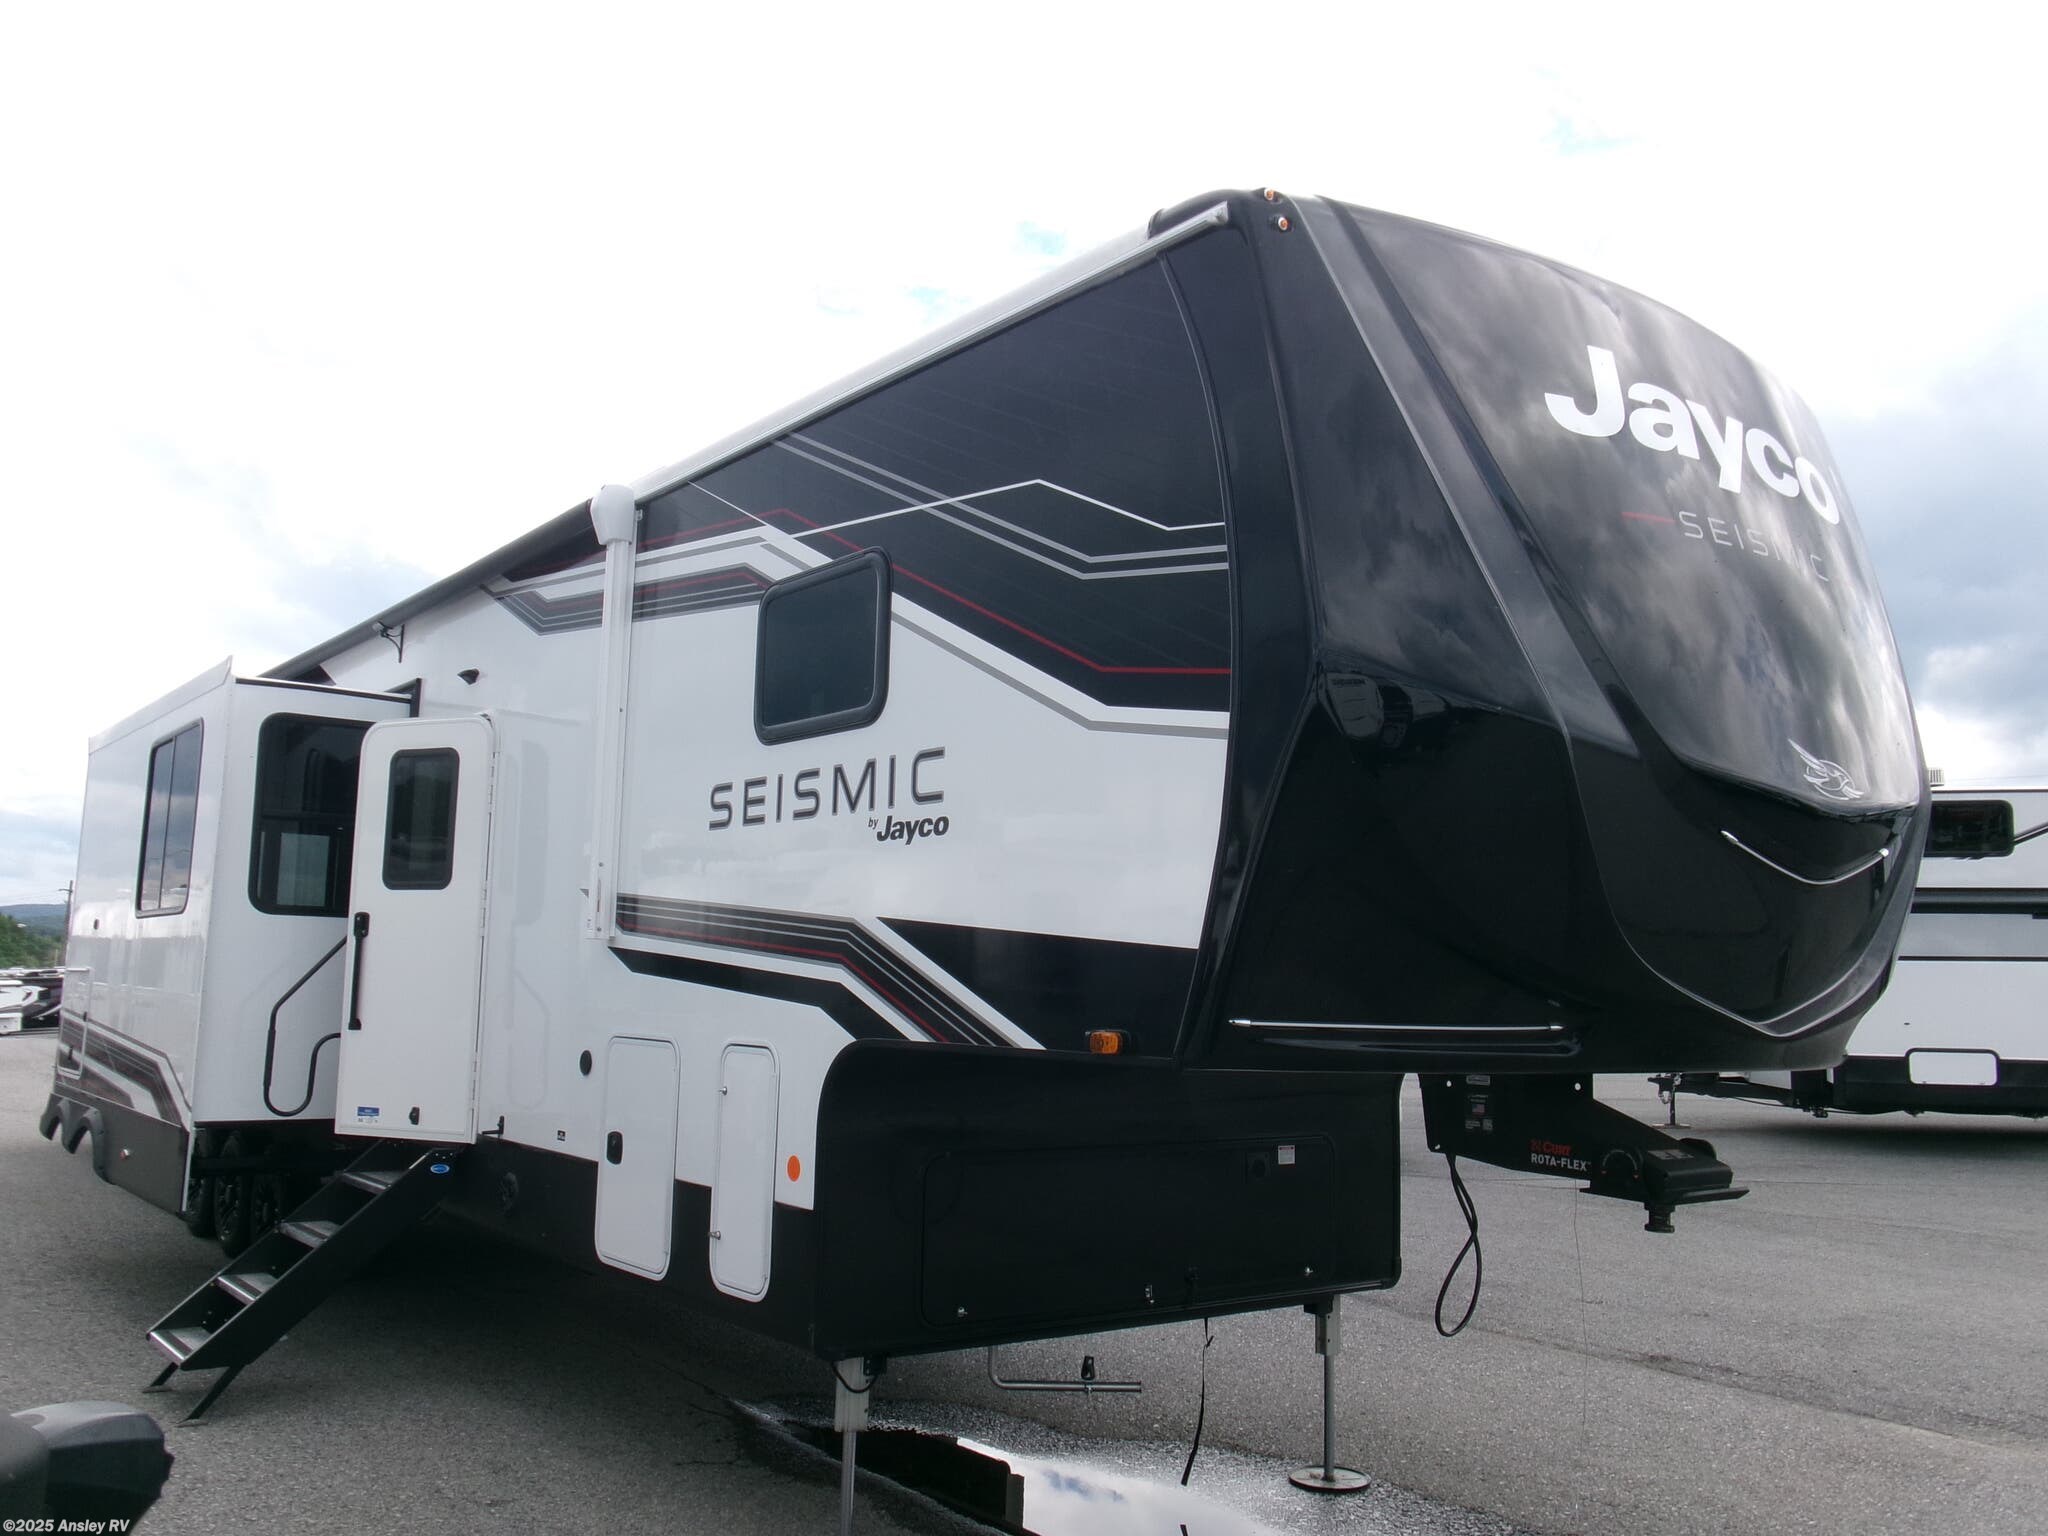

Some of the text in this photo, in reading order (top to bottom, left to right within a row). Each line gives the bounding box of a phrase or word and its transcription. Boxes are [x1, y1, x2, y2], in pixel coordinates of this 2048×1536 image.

[1544, 345, 1840, 525] Jayco
[708, 746, 946, 831] SEISMIC
[867, 815, 950, 845] by Jayco
